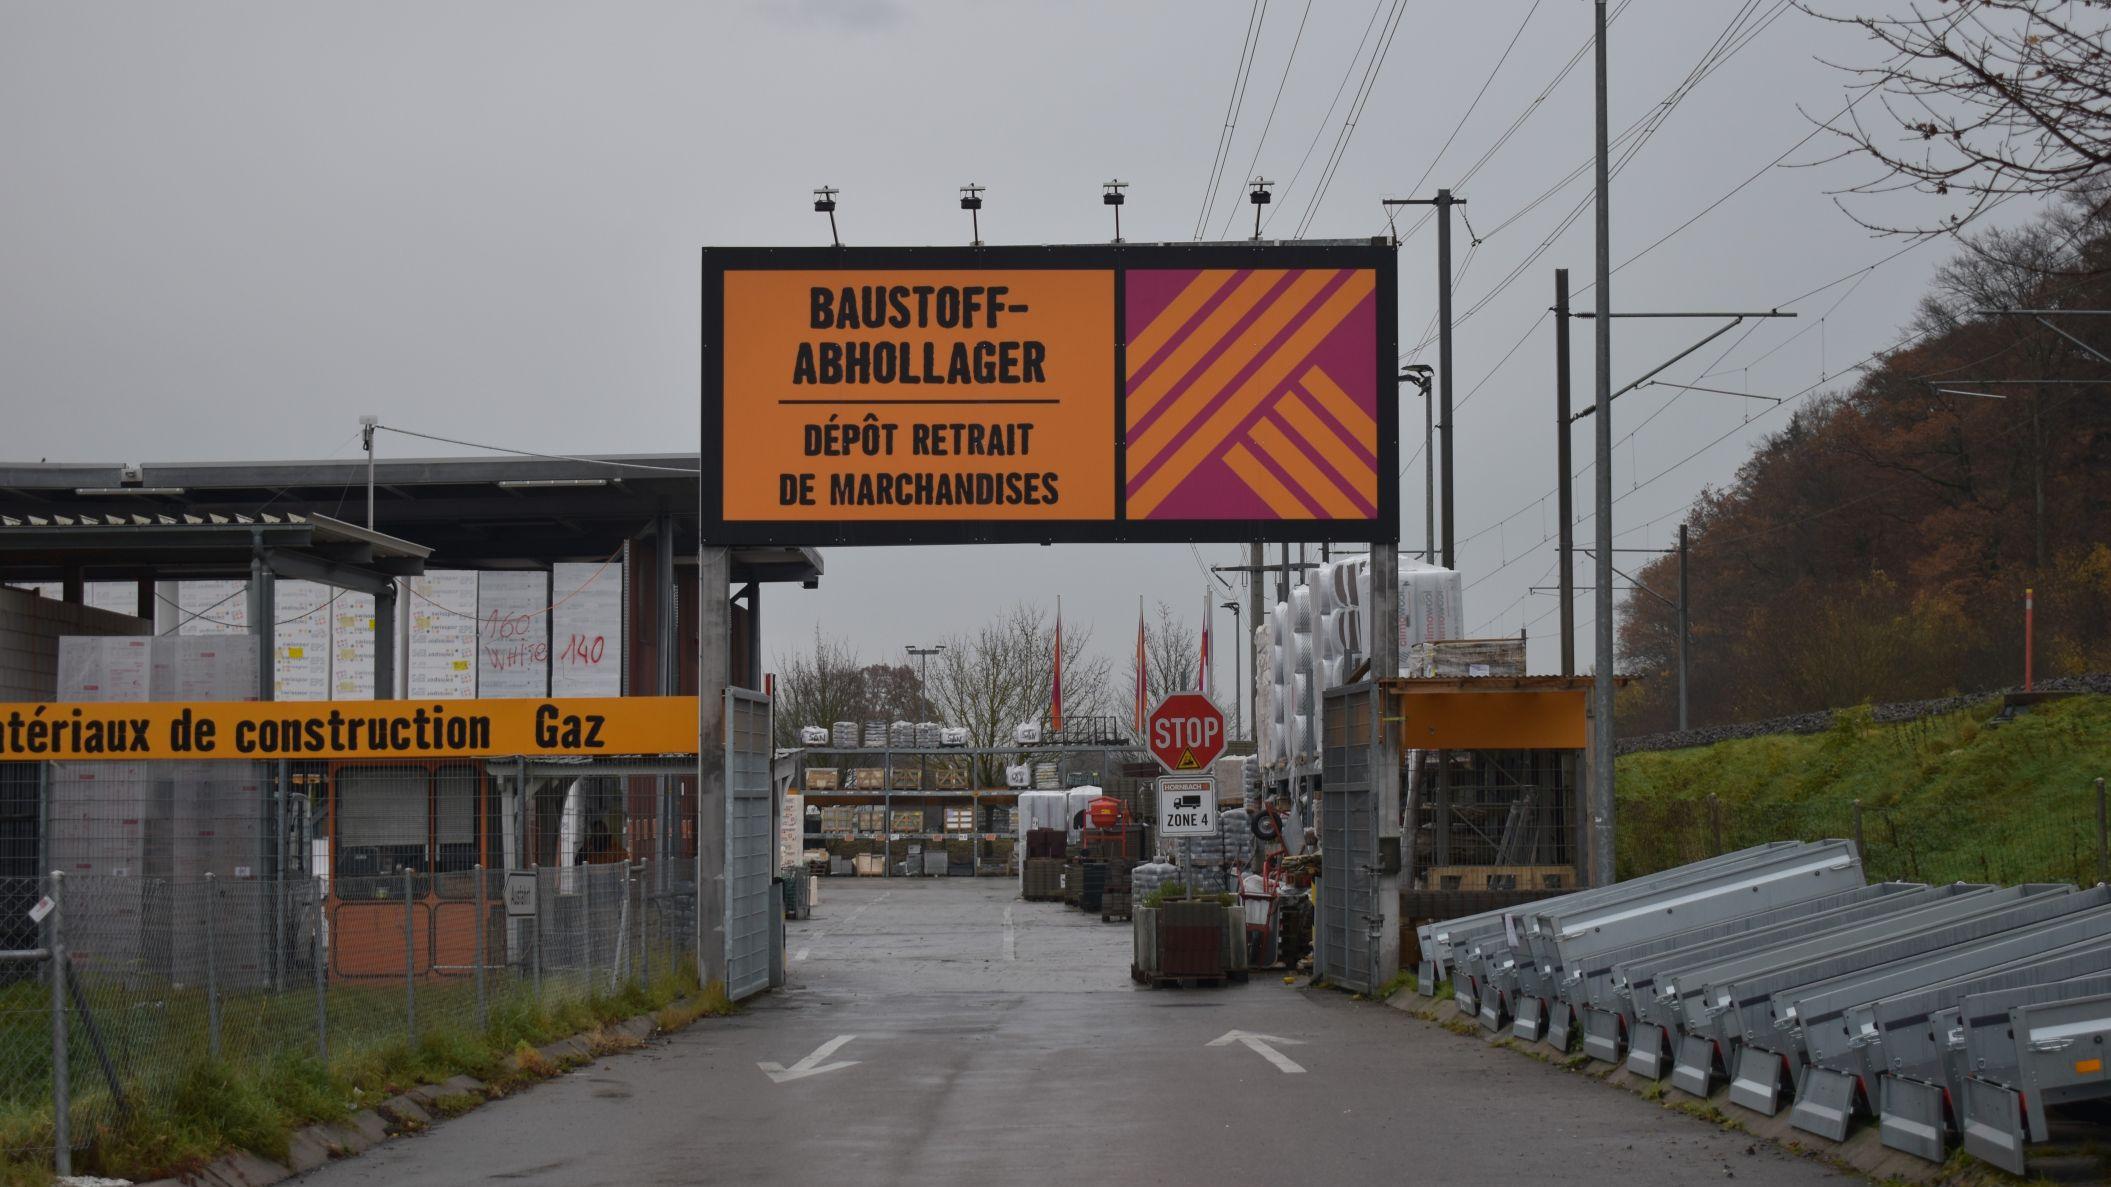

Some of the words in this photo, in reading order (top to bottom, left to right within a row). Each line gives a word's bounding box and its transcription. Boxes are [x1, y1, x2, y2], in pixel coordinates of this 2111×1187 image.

[811, 286, 1028, 330] BAUSTOFF-
[792, 341, 1046, 385] ABHOLLAGER
[804, 413, 898, 457] DÉPÔT
[912, 423, 1034, 457] RETRAIT
[780, 474, 815, 505] DE
[830, 472, 1059, 506] MARCHANDISES
[485, 609, 530, 638] 160
[1423, 591, 1434, 640] limowool
[1437, 590, 1446, 640] limowool
[561, 634, 604, 664] 140
[0, 704, 150, 754] tériaux
[171, 708, 216, 753] de
[236, 704, 490, 753] construction
[535, 703, 606, 749] Gaz
[1155, 717, 1218, 748] STOP
[1164, 783, 1202, 791] HORNBACH
[1167, 813, 1198, 827] ZONE
[1201, 813, 1209, 827] 4
